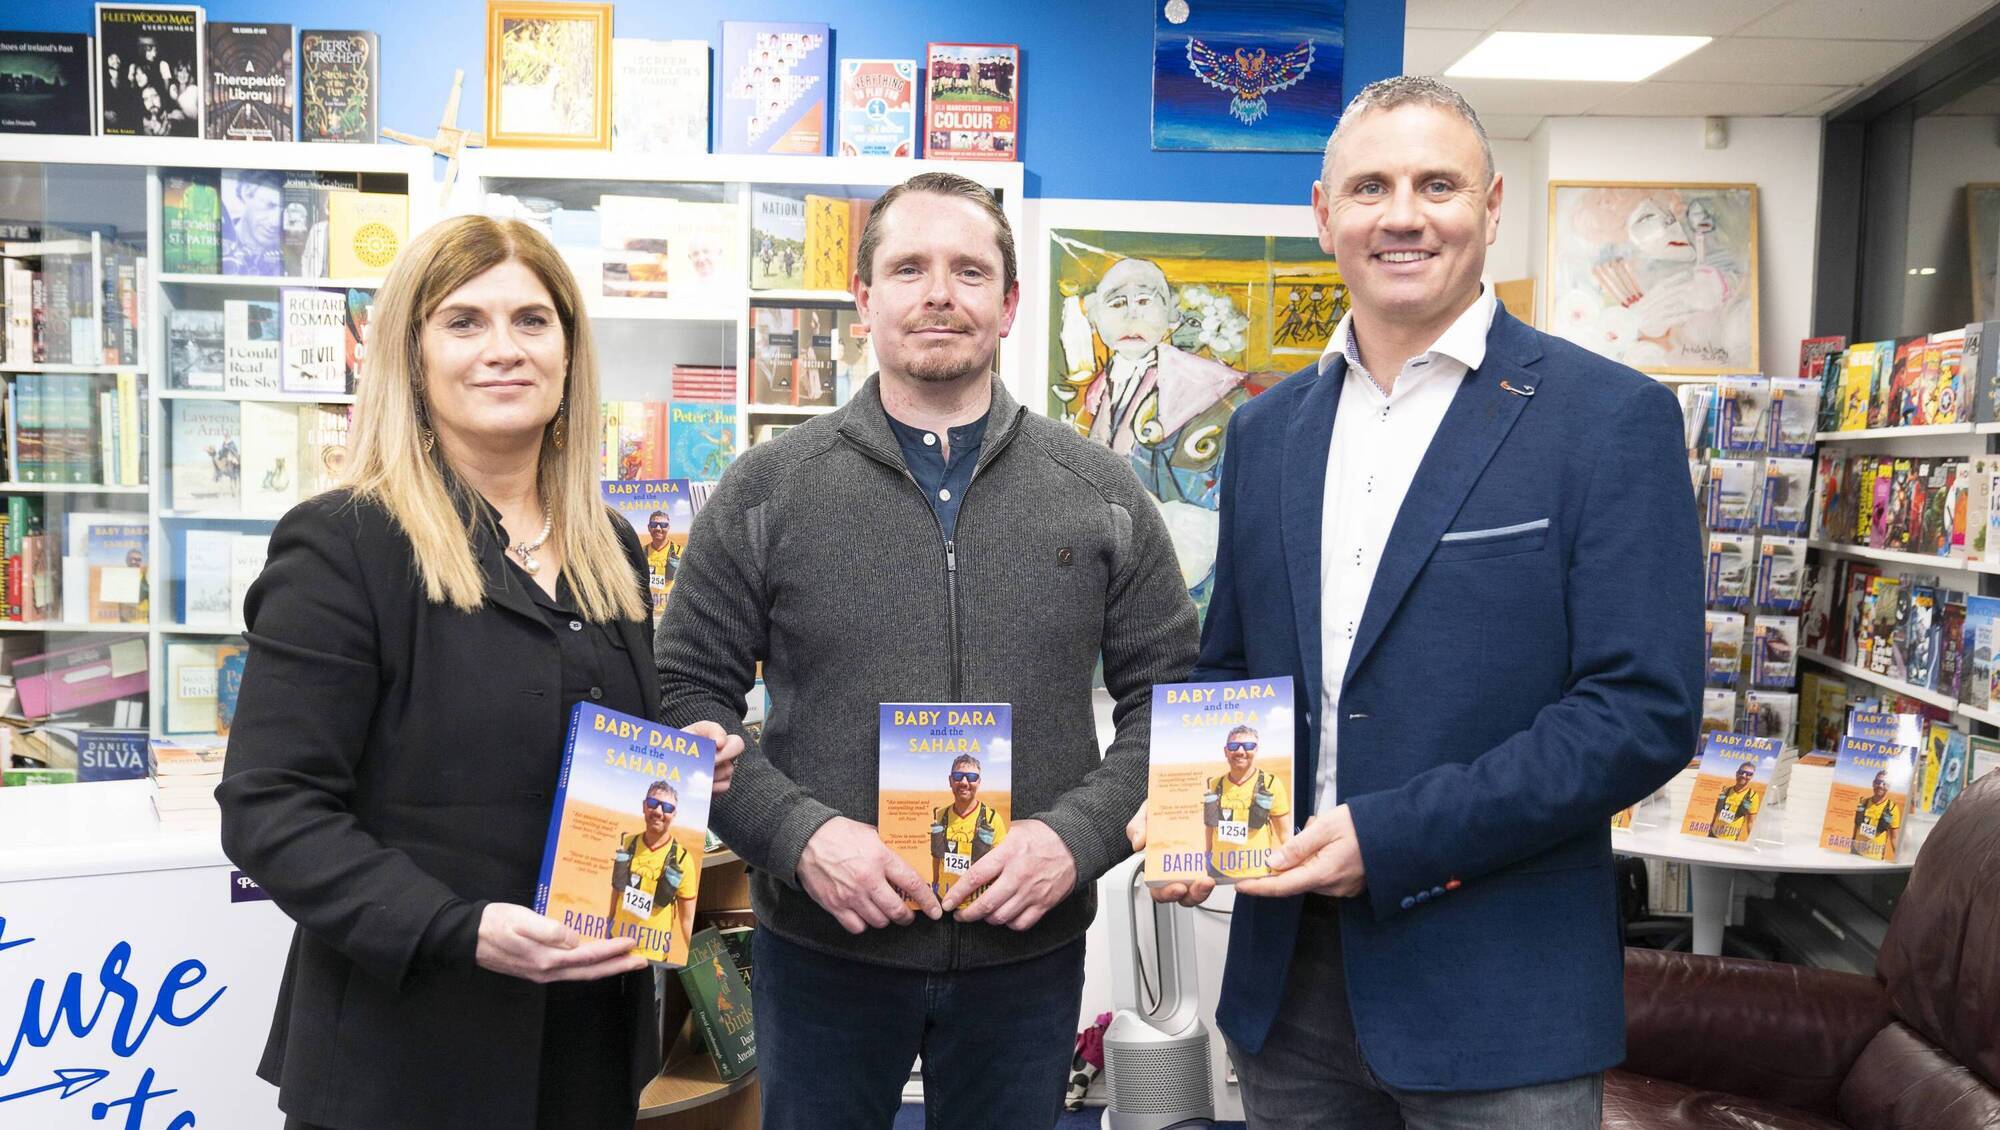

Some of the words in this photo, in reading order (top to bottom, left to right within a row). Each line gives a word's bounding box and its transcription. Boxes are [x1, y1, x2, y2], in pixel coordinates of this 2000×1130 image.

[102, 12, 167, 24] FLEETWOOD
[169, 13, 195, 24] MAC
[319, 39, 351, 52] TERRY
[245, 60, 255, 73] A
[214, 72, 287, 89] Therapeutic
[853, 73, 904, 91] VERYTHING
[229, 88, 272, 105] Library
[934, 111, 993, 129] COLOUR
[762, 200, 798, 216] NATION
[289, 299, 346, 311] RICHARD
[289, 313, 346, 327] OSMAN
[237, 347, 278, 358] Could
[302, 346, 335, 365] DEVIL
[230, 362, 263, 373] Read
[230, 377, 249, 388] the
[671, 408, 706, 424] Peter
[714, 412, 736, 425] Pan
[608, 484, 640, 494] BABY
[645, 483, 679, 493] DARA
[619, 500, 669, 511] SAHARA
[650, 577, 665, 585] 254
[1167, 688, 1216, 705] BABY
[1223, 684, 1276, 702] DARA
[1203, 702, 1222, 711] and
[1224, 701, 1240, 710] the
[895, 711, 941, 726] BABY
[948, 711, 996, 726] DARA
[1181, 711, 1259, 728] SAHARA
[1857, 714, 1883, 725] BABY
[594, 713, 643, 741] BABY
[649, 730, 700, 759] DARA
[930, 727, 947, 736] and
[949, 727, 964, 736] the
[87, 741, 137, 752] DANIEL
[629, 742, 647, 754] and
[649, 747, 665, 759] the
[908, 738, 981, 753] SAHARA
[1715, 734, 1742, 746] BABY
[1744, 738, 1773, 752] DARA
[1847, 740, 1875, 752] BABY
[1879, 745, 1903, 757] DAR
[82, 750, 144, 769] SILVA
[1720, 749, 1760, 763] SAHARA
[603, 748, 682, 784] SAHARA
[1220, 825, 1247, 838] 1254
[945, 856, 970, 870] 1254
[1163, 852, 1214, 873] BARRY
[1220, 848, 1272, 871] LOFTUS
[626, 892, 651, 912] 1254
[724, 1003, 753, 1036] Birds
